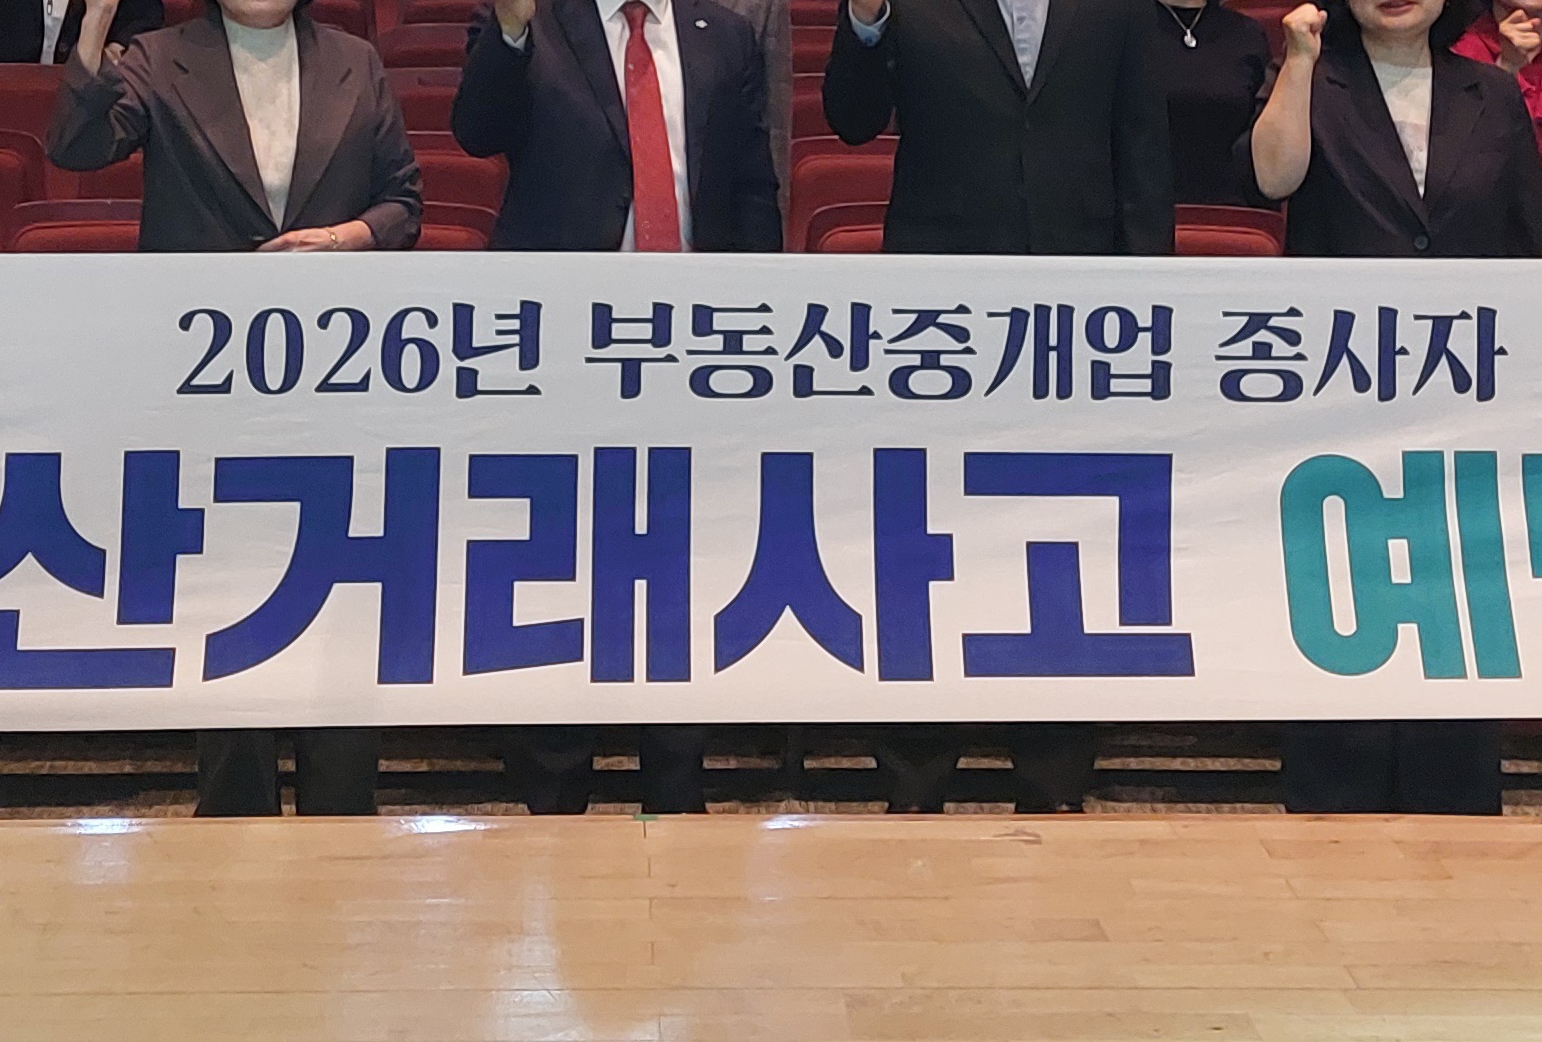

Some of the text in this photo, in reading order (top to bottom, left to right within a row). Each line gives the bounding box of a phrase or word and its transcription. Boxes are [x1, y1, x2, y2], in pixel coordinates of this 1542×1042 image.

[175, 299, 1509, 402] 2026년 부동산중개업 종사자
